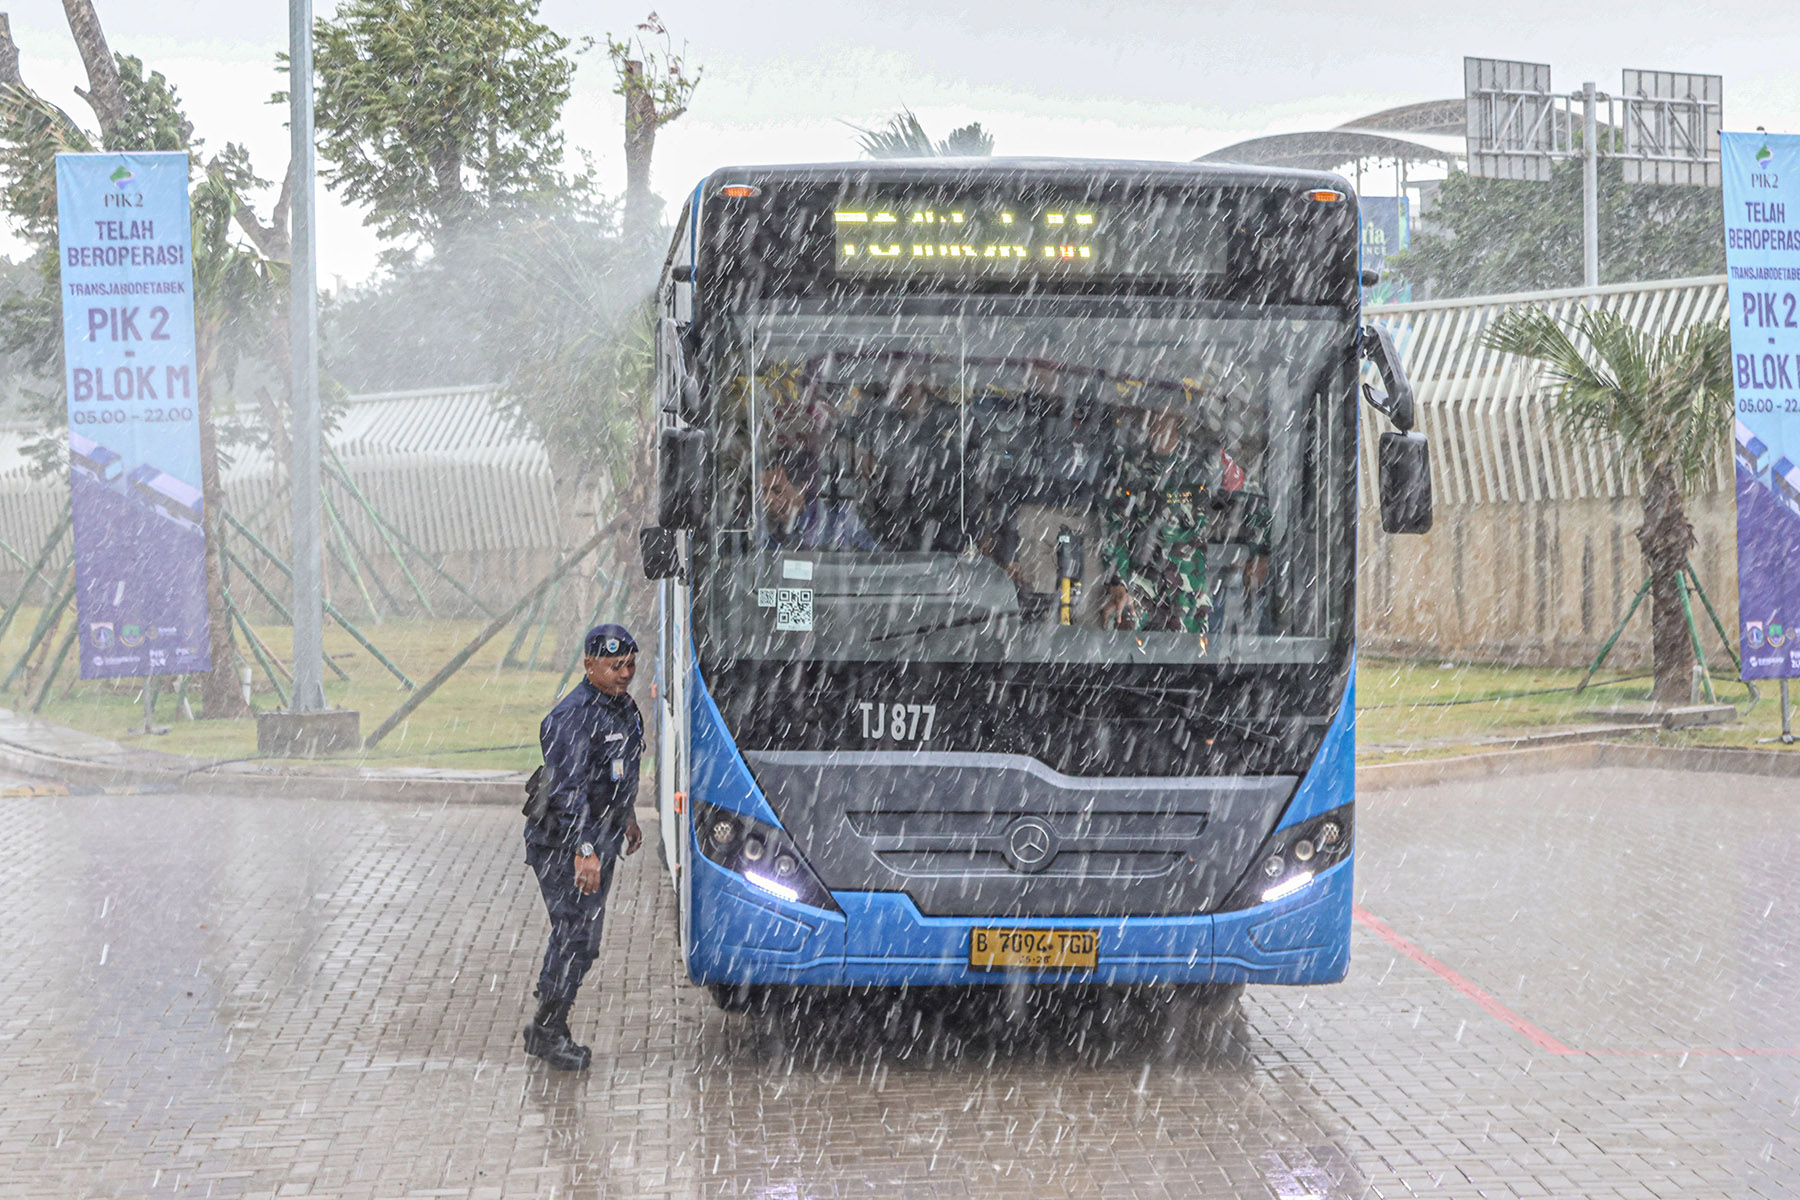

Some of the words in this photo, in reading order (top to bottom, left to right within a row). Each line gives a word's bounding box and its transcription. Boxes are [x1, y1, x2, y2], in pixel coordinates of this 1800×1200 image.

[1745, 202, 1785, 224] TELAH
[95, 220, 154, 240] TELAH
[67, 245, 184, 267] BEROPERASI
[69, 281, 185, 296] TRANSJABODETABEK
[1742, 292, 1780, 328] PIK
[1784, 292, 1797, 328] 2
[88, 306, 143, 342] PIK
[150, 306, 170, 341] 2
[1736, 353, 1792, 389] BLOK
[73, 365, 157, 402] BLOK
[167, 365, 190, 399] M
[74, 410, 126, 425] 05.00
[144, 408, 193, 422] 22.00
[1739, 398, 1773, 413] 05.00
[859, 702, 885, 739] TJ
[891, 703, 936, 741] 877
[977, 933, 987, 952] B
[1058, 934, 1094, 954] TGD
